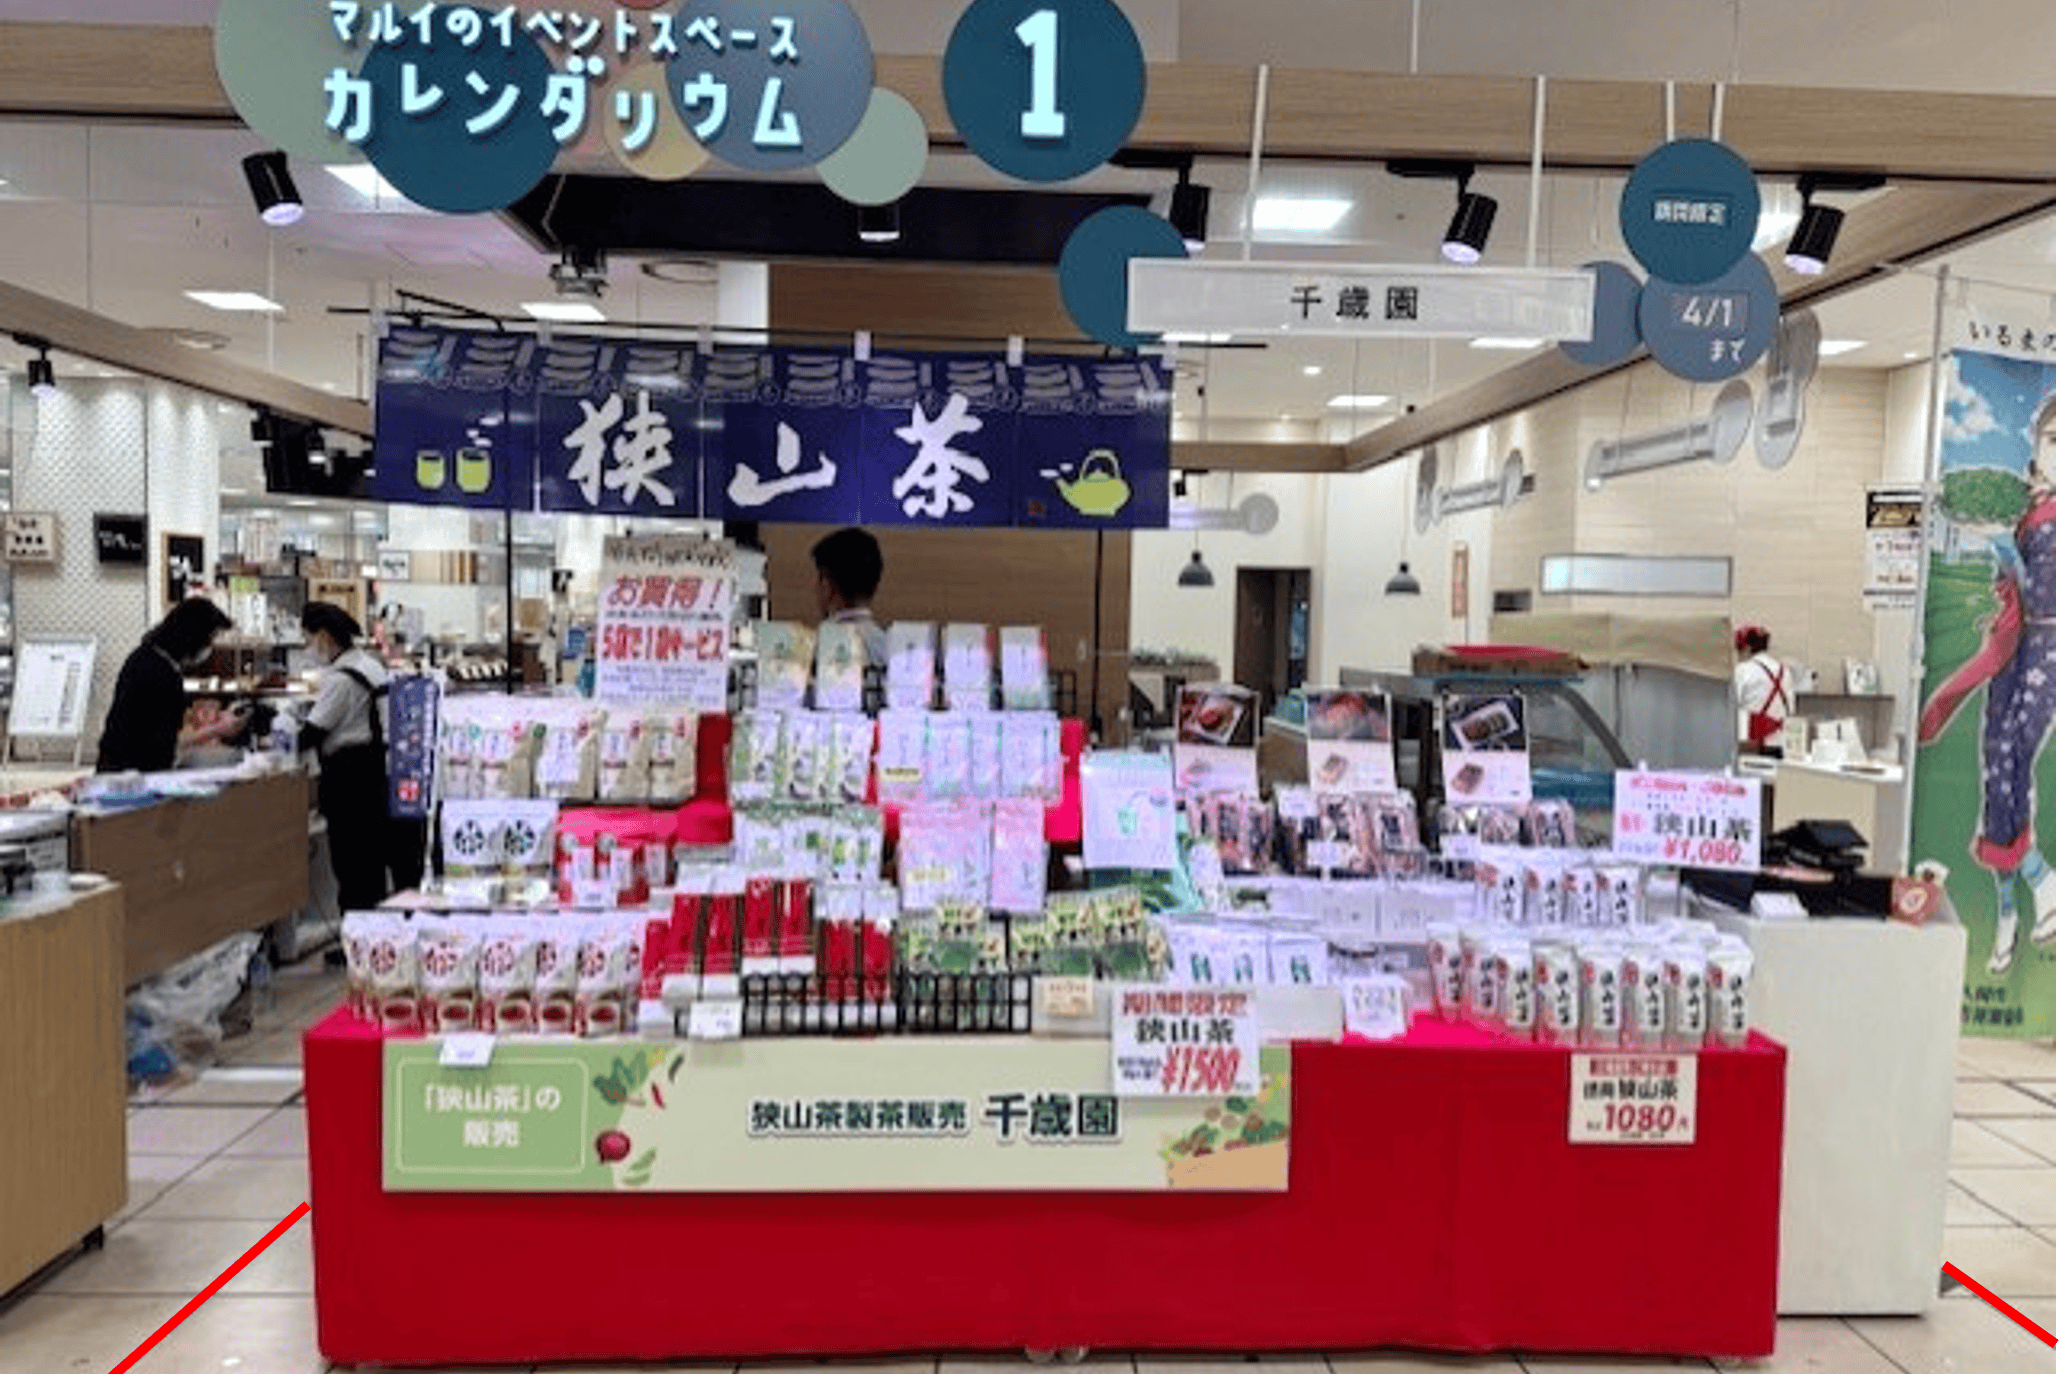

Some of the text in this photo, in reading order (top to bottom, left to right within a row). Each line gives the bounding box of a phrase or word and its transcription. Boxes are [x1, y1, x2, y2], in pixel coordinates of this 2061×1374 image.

[329, 1, 798, 60] マルイのイベントスペース
[1015, 10, 1066, 137] 1
[324, 55, 801, 151] カレンダリウム
[1291, 286, 1418, 320] 千歳園
[1682, 296, 1732, 327] 4/1
[1710, 338, 1745, 363] まで
[563, 391, 990, 519] 狭山茶
[1136, 1018, 1234, 1043] 狭山茶
[985, 1094, 1118, 1138] 千歳園
[1604, 1104, 1676, 1131] 1080
[464, 1120, 520, 1147] 販売
